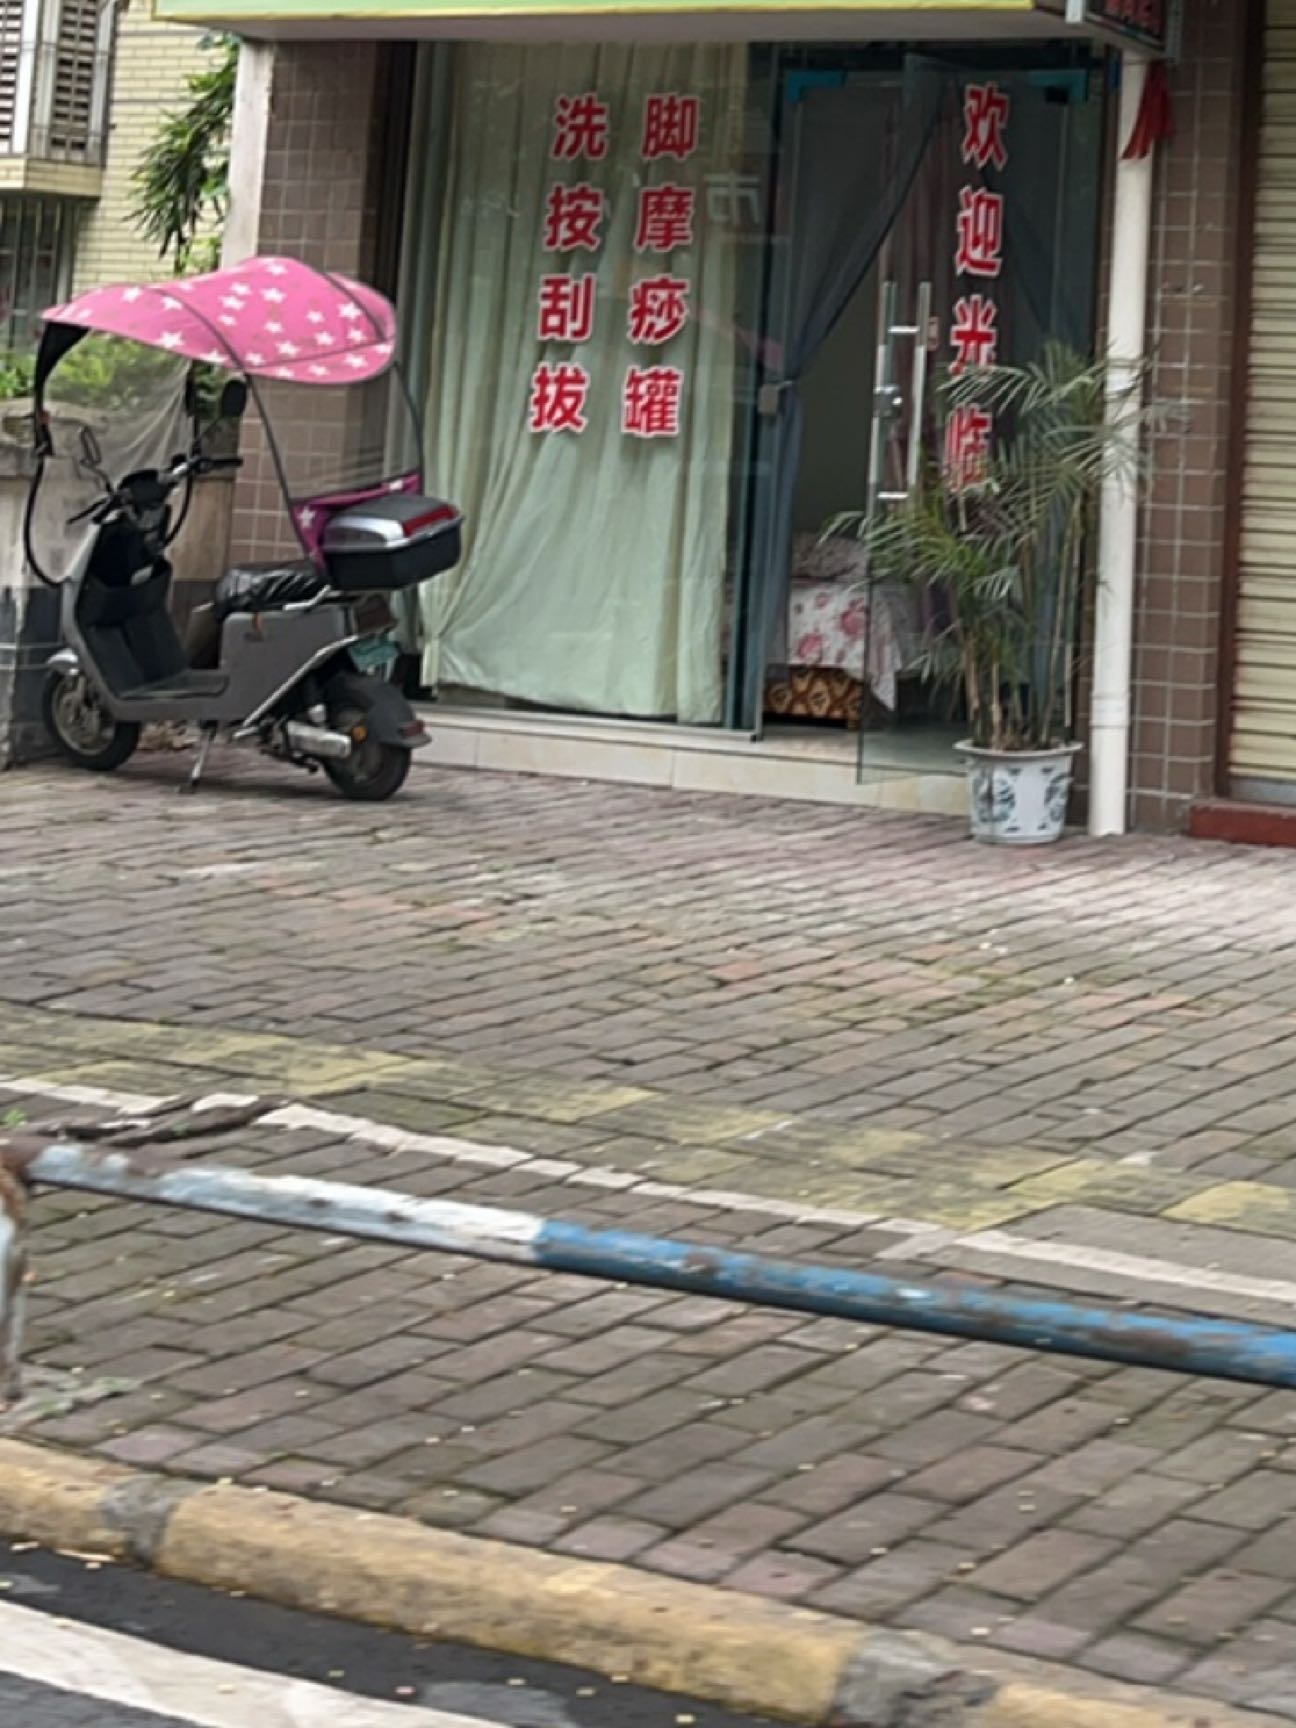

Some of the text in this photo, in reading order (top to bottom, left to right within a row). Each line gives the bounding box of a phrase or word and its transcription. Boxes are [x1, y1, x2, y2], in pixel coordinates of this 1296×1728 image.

[551, 93, 698, 160] 洗脚
[543, 185, 694, 252] 按摩
[537, 275, 688, 344] 刮痧
[944, 80, 1010, 494] 欢迎光临
[528, 364, 683, 439] 拔罐
